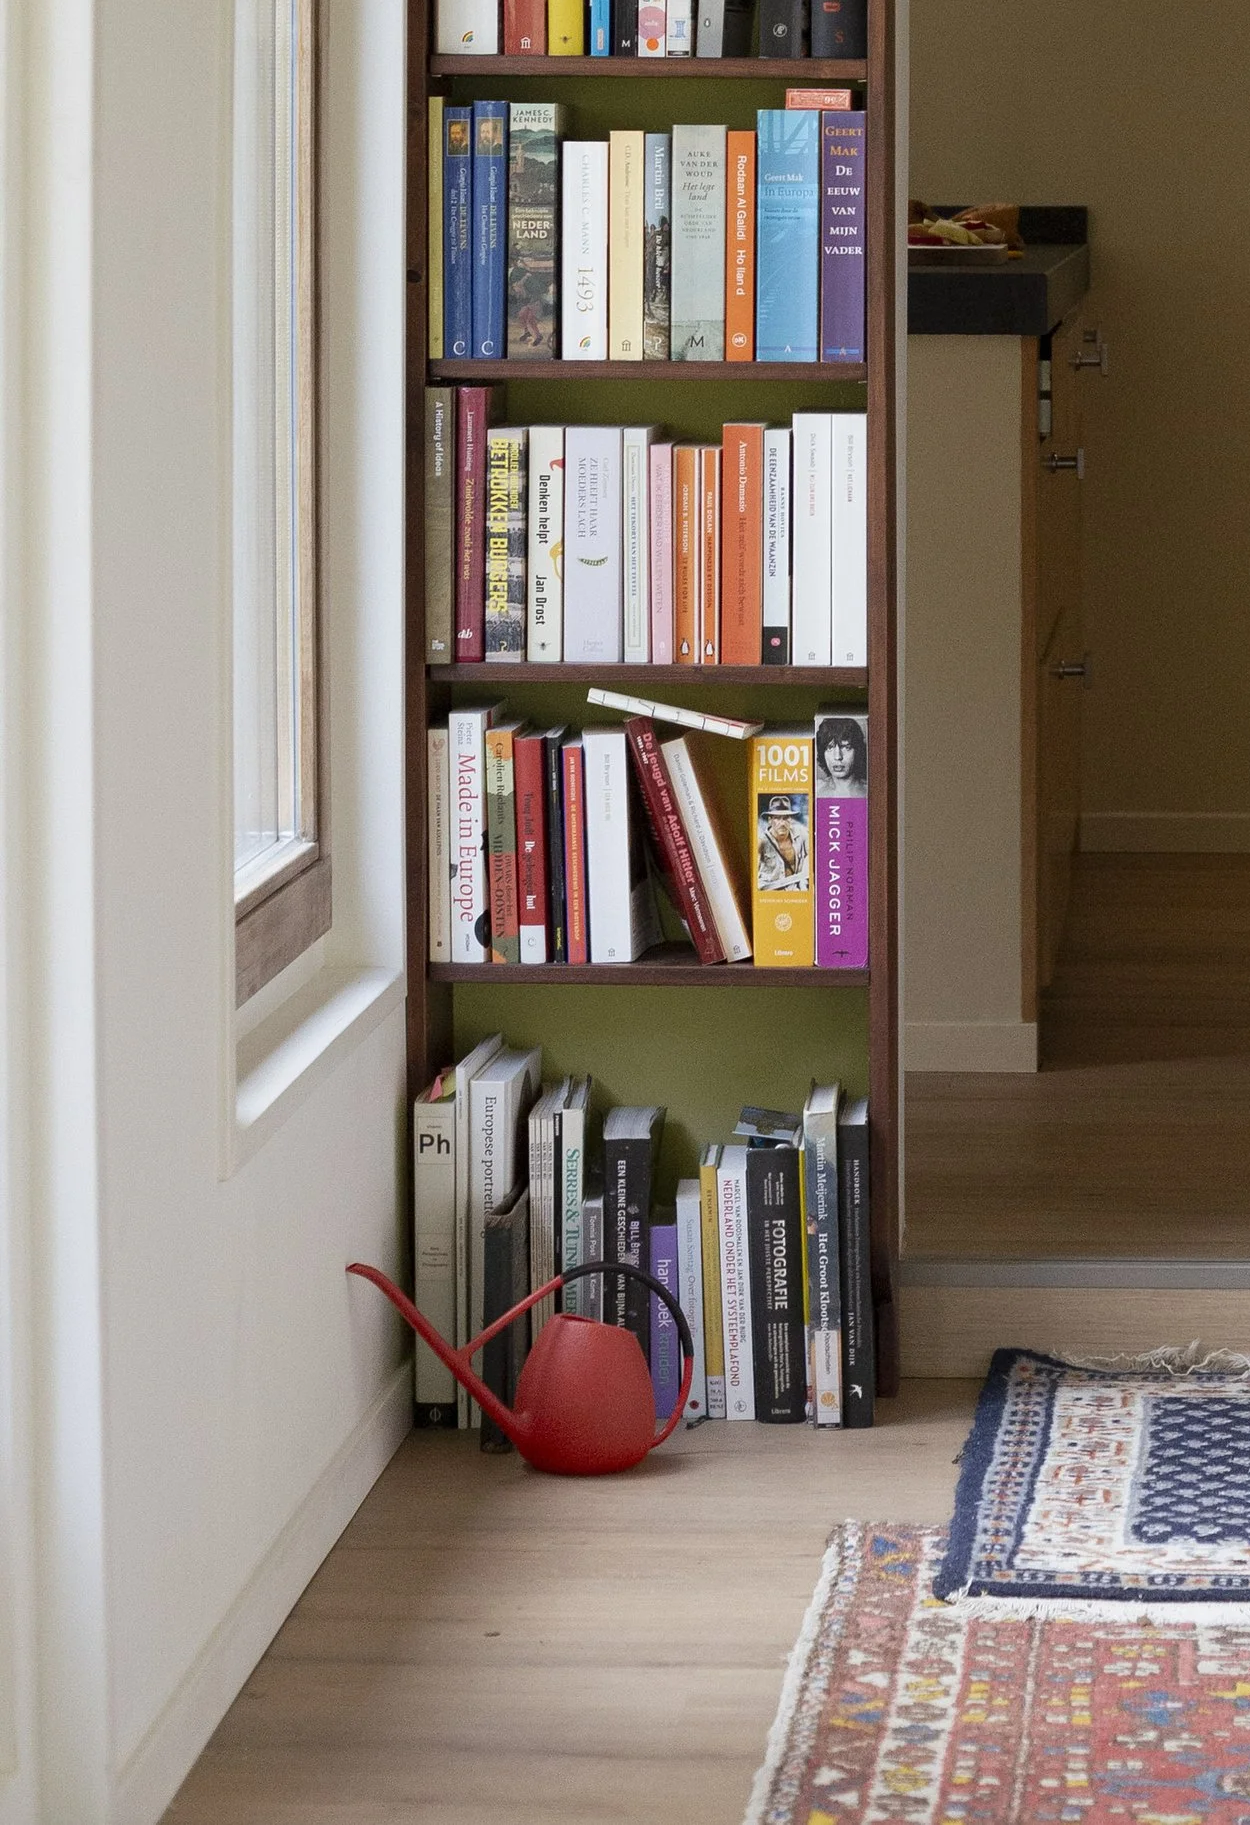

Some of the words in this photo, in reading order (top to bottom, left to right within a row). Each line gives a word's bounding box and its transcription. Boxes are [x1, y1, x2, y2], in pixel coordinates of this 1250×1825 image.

[515, 109, 541, 117] JAMES
[581, 154, 590, 203] CHARLES
[654, 146, 665, 185] Martin
[737, 154, 748, 196] Rodaan
[764, 174, 786, 182] Geert
[786, 174, 804, 182] Mak
[654, 188, 664, 210] Bril
[682, 182, 699, 191] Het
[699, 182, 715, 193] lege
[688, 192, 708, 201] land
[737, 197, 748, 208] Al
[764, 187, 776, 196] In
[777, 187, 815, 199] Europa
[827, 187, 861, 196] EEUW
[737, 209, 748, 241] Galidi
[832, 207, 856, 216] VAN
[516, 230, 548, 239] LAND
[581, 221, 590, 255] MANN
[829, 226, 858, 237] MIJN
[824, 246, 863, 256] VADER
[575, 266, 595, 313] 1493
[432, 409, 444, 441] History
[433, 442, 444, 452] of
[738, 440, 747, 476] Antonio
[769, 447, 777, 458] DE
[588, 457, 598, 471] ZE
[489, 438, 509, 532] BETROKKEN
[538, 474, 551, 513] Denken
[576, 457, 586, 508] MOEDERS
[588, 473, 598, 505] HEEFT
[738, 476, 747, 513] Damasio
[463, 478, 475, 525] Zuidwolde
[538, 517, 551, 545] helpt
[588, 508, 598, 537] HAAR
[769, 513, 777, 529] VAN
[769, 529, 777, 540] DE
[768, 540, 777, 577] WAANZIN
[489, 537, 509, 613] BURGERS
[535, 574, 548, 593] Jan
[535, 597, 548, 626] Drost
[465, 722, 474, 745] Pieter
[495, 742, 505, 782] Carolien
[757, 745, 809, 767] 1001
[457, 753, 478, 812] Made
[759, 768, 809, 783] FILMS
[642, 731, 653, 748] De
[660, 789, 672, 813] van
[666, 813, 683, 846] Adolf
[679, 847, 695, 884] Hitler
[458, 817, 479, 836] in
[828, 806, 841, 853] MICK
[846, 821, 854, 863] PHILIP
[523, 839, 536, 854] De
[453, 844, 477, 922] Europe
[492, 833, 505, 938] MIDDEN-OOSTEN
[828, 858, 841, 937] JAGGER
[845, 867, 854, 921] NORMAN
[480, 1096, 497, 1156] Europese
[420, 1133, 450, 1154] Ph
[816, 1137, 826, 1171] Martin
[565, 1147, 580, 1207] SERRES
[617, 1160, 626, 1177] EEN
[853, 1158, 861, 1205] HANDBOEK
[617, 1178, 626, 1208] KLEINE
[723, 1180, 734, 1238] NEDERLAND
[816, 1172, 828, 1221] Meijerink
[566, 1209, 580, 1222] &
[686, 1218, 695, 1243] Susan
[685, 1244, 696, 1273] Sontag
[725, 1242, 735, 1275] ONDER
[818, 1232, 829, 1253] Het
[772, 1219, 788, 1310] FOTOGRAFIE
[818, 1255, 831, 1289] Groot
[687, 1275, 697, 1295] Over
[726, 1278, 736, 1296] HET
[658, 1333, 672, 1385] kruiden
[727, 1300, 740, 1387] SYSTEEMPLAFOND
